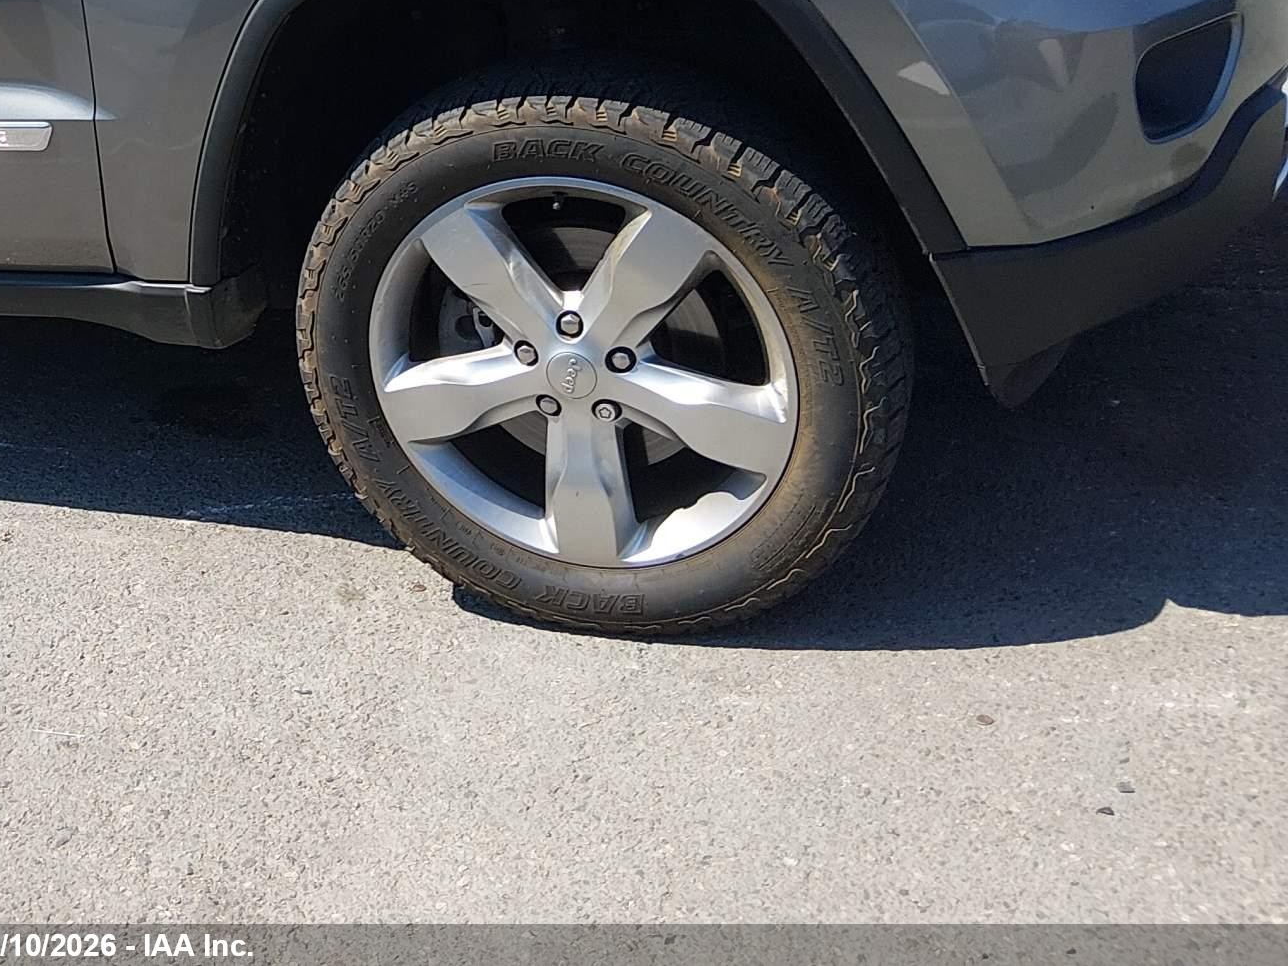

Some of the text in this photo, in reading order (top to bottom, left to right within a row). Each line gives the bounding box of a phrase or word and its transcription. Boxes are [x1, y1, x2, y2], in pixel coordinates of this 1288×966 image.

[491, 137, 605, 163] BACK
[619, 151, 795, 267] COUNTRY
[534, 584, 648, 616] BACK
